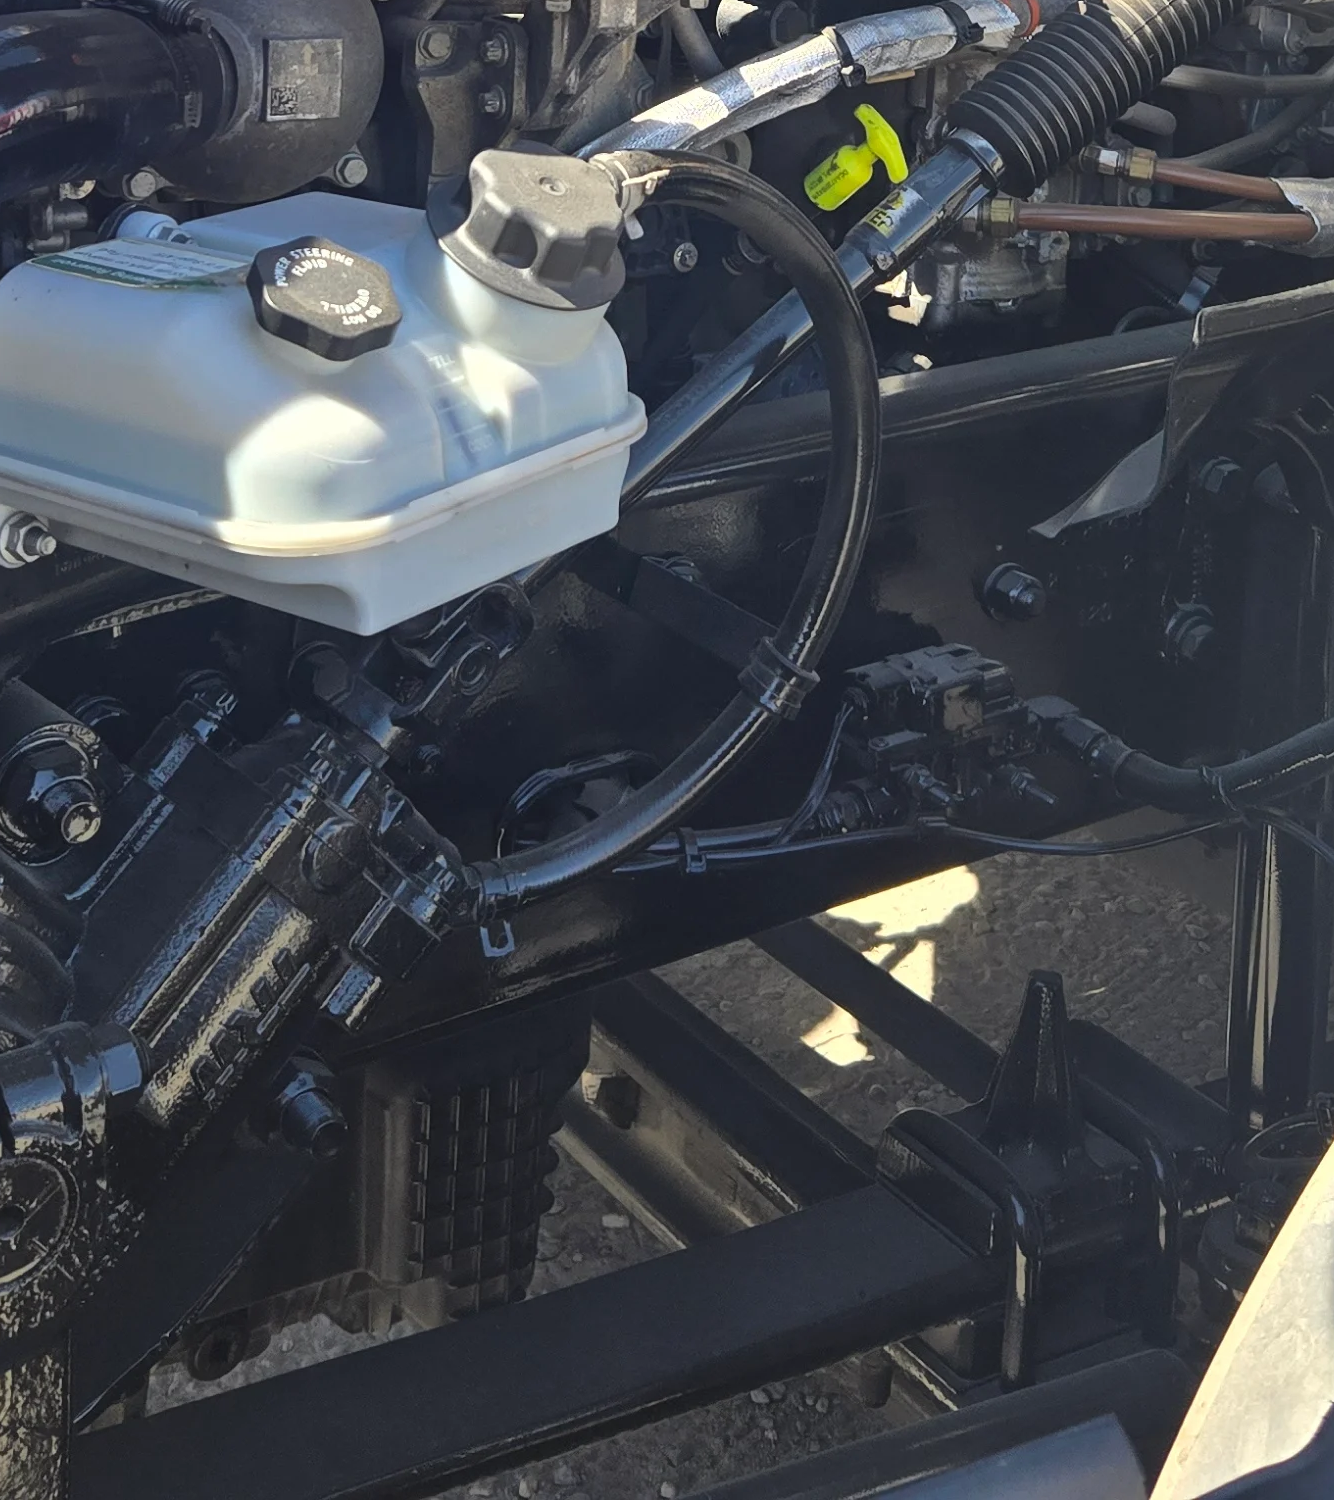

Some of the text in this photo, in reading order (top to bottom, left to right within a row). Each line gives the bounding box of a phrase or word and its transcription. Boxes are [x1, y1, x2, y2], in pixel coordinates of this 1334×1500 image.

[273, 247, 355, 287] POWER STEERING
[291, 258, 328, 277] FLUID
[320, 288, 371, 314] OVERFILL
[342, 304, 383, 326] DO NOT
